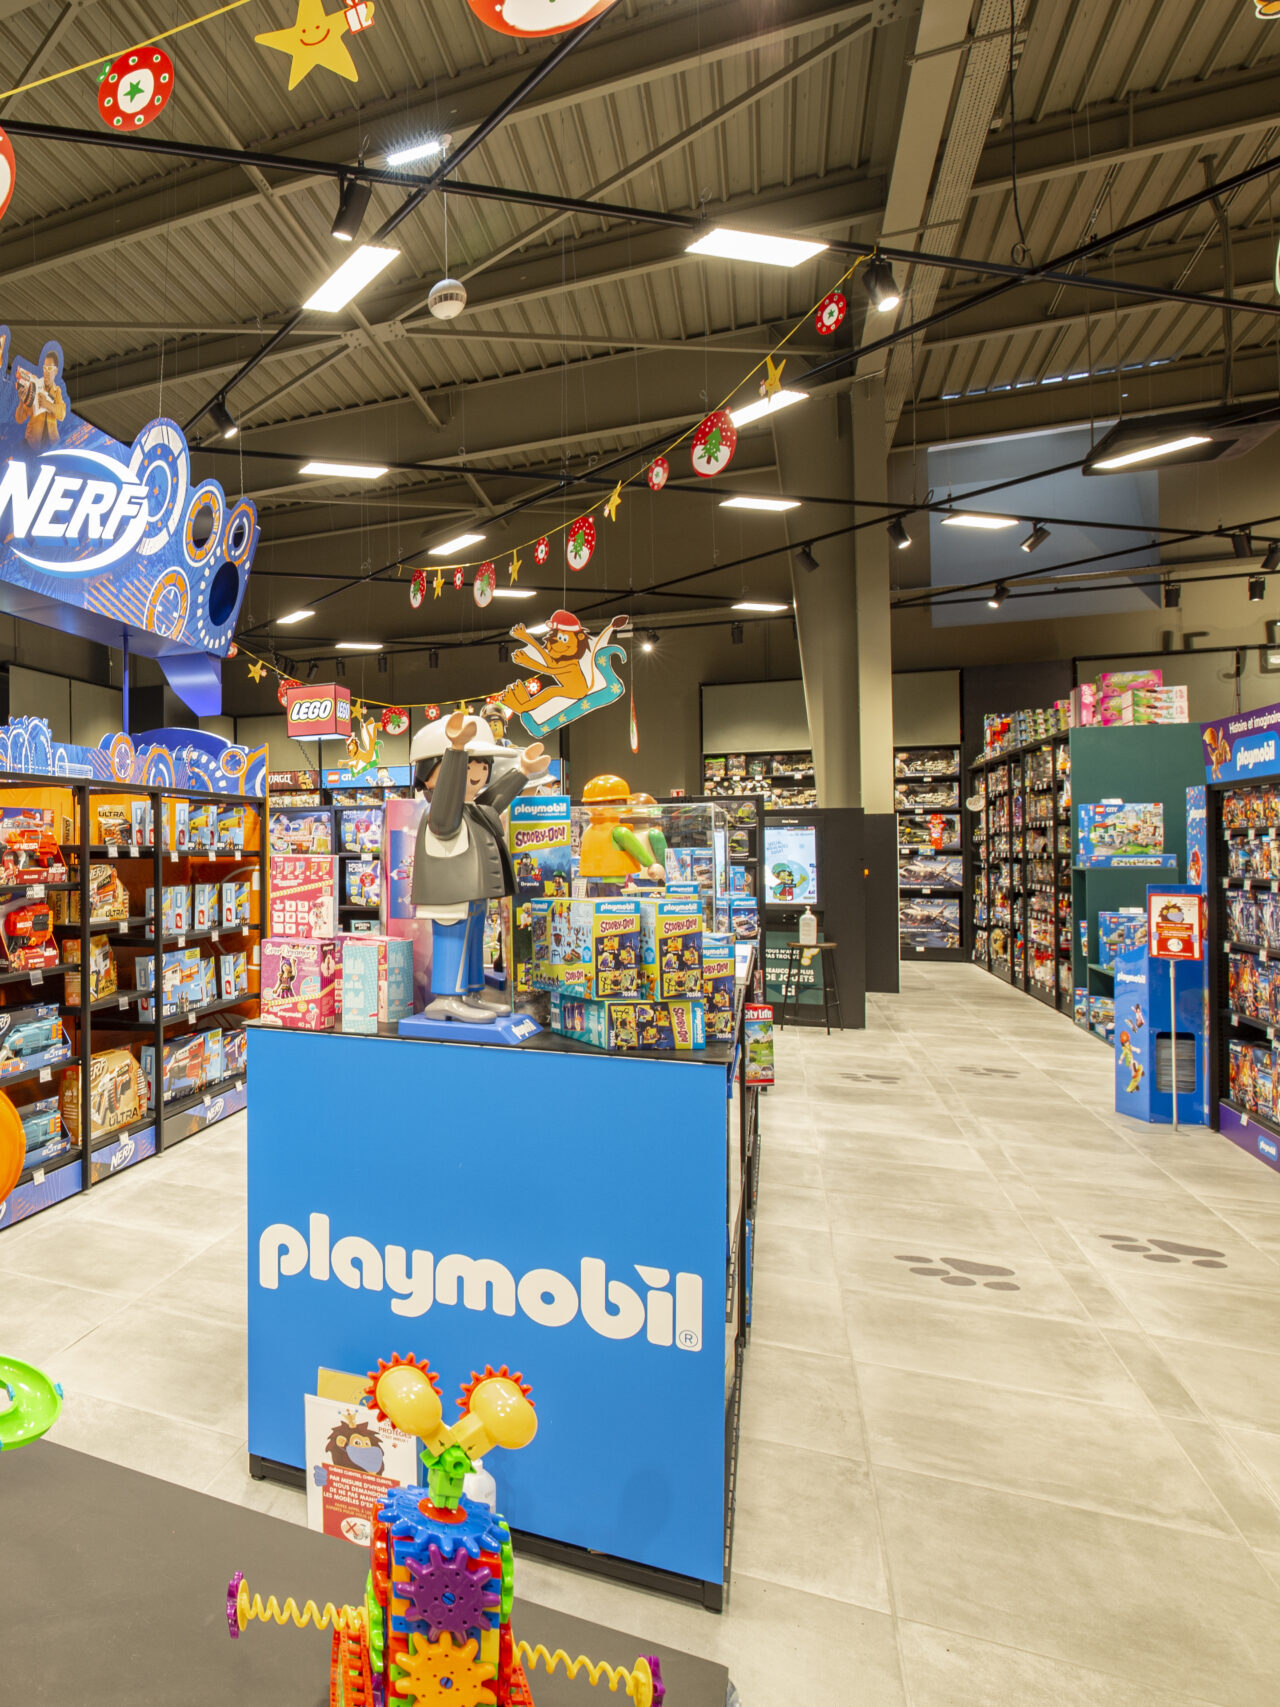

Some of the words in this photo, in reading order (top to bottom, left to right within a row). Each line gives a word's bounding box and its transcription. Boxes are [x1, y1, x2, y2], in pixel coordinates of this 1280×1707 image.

[291, 700, 332, 720] LEGO
[337, 700, 350, 720] LEGO
[1229, 719, 1247, 734] Histoire
[1248, 717, 1254, 730] et
[1236, 740, 1276, 771] playmobil
[514, 802, 567, 816] playmobil
[106, 909, 125, 918] ULTRA
[600, 902, 635, 912] playmobil
[663, 902, 698, 912] playmobil
[758, 1009, 772, 1019] Life
[109, 1106, 139, 1127] ULTRA
[110, 1140, 135, 1172] NERF
[340, 1477, 363, 1487] MESURE
[323, 1491, 333, 1499] LES
[333, 1481, 350, 1491] NOUS
[351, 1486, 388, 1498] DEMANDON
[347, 1490, 358, 1499] PAS
